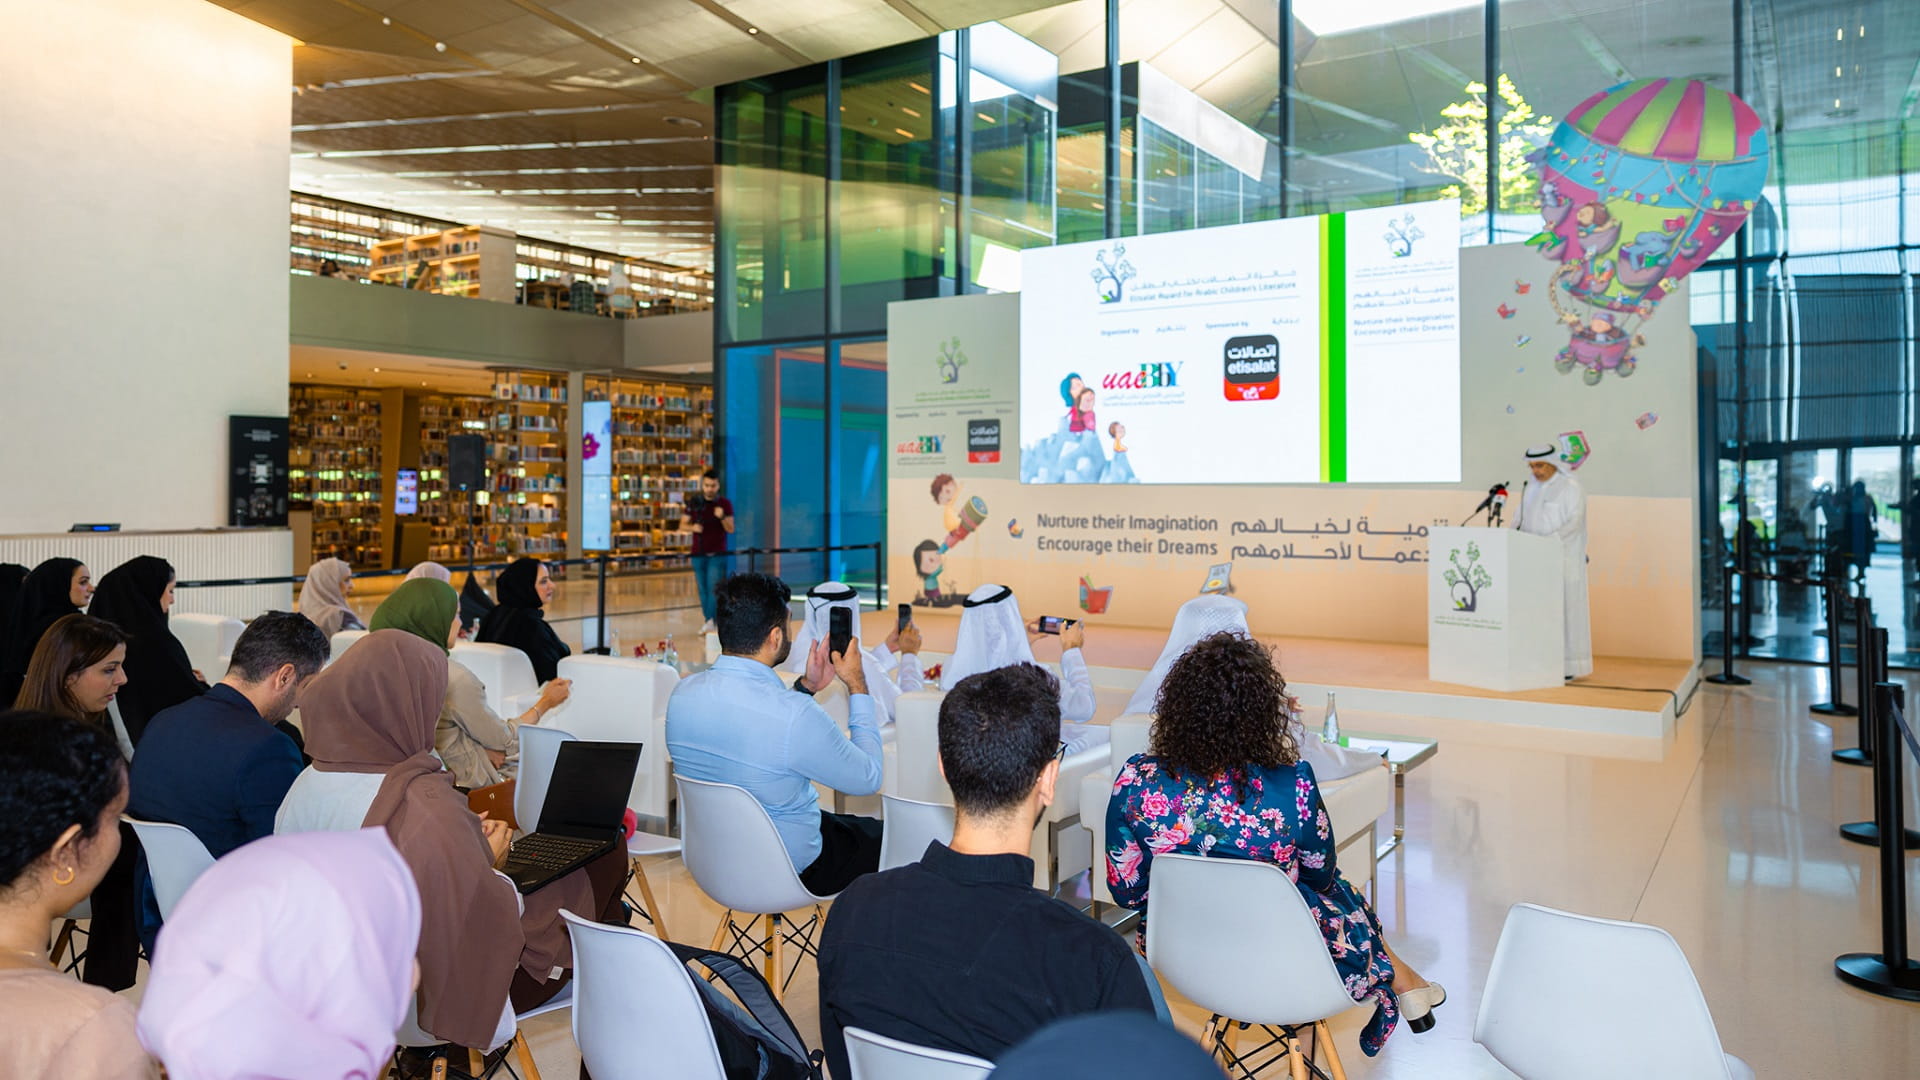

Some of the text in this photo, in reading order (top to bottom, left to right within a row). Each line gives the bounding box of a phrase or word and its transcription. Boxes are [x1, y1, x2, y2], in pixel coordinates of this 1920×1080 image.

[1227, 344, 1277, 360] اتصالات
[1227, 359, 1277, 375] etisalat
[1037, 514, 1218, 534] Nurture their Imagination
[1037, 535, 1219, 556] Encourage their Dreams
